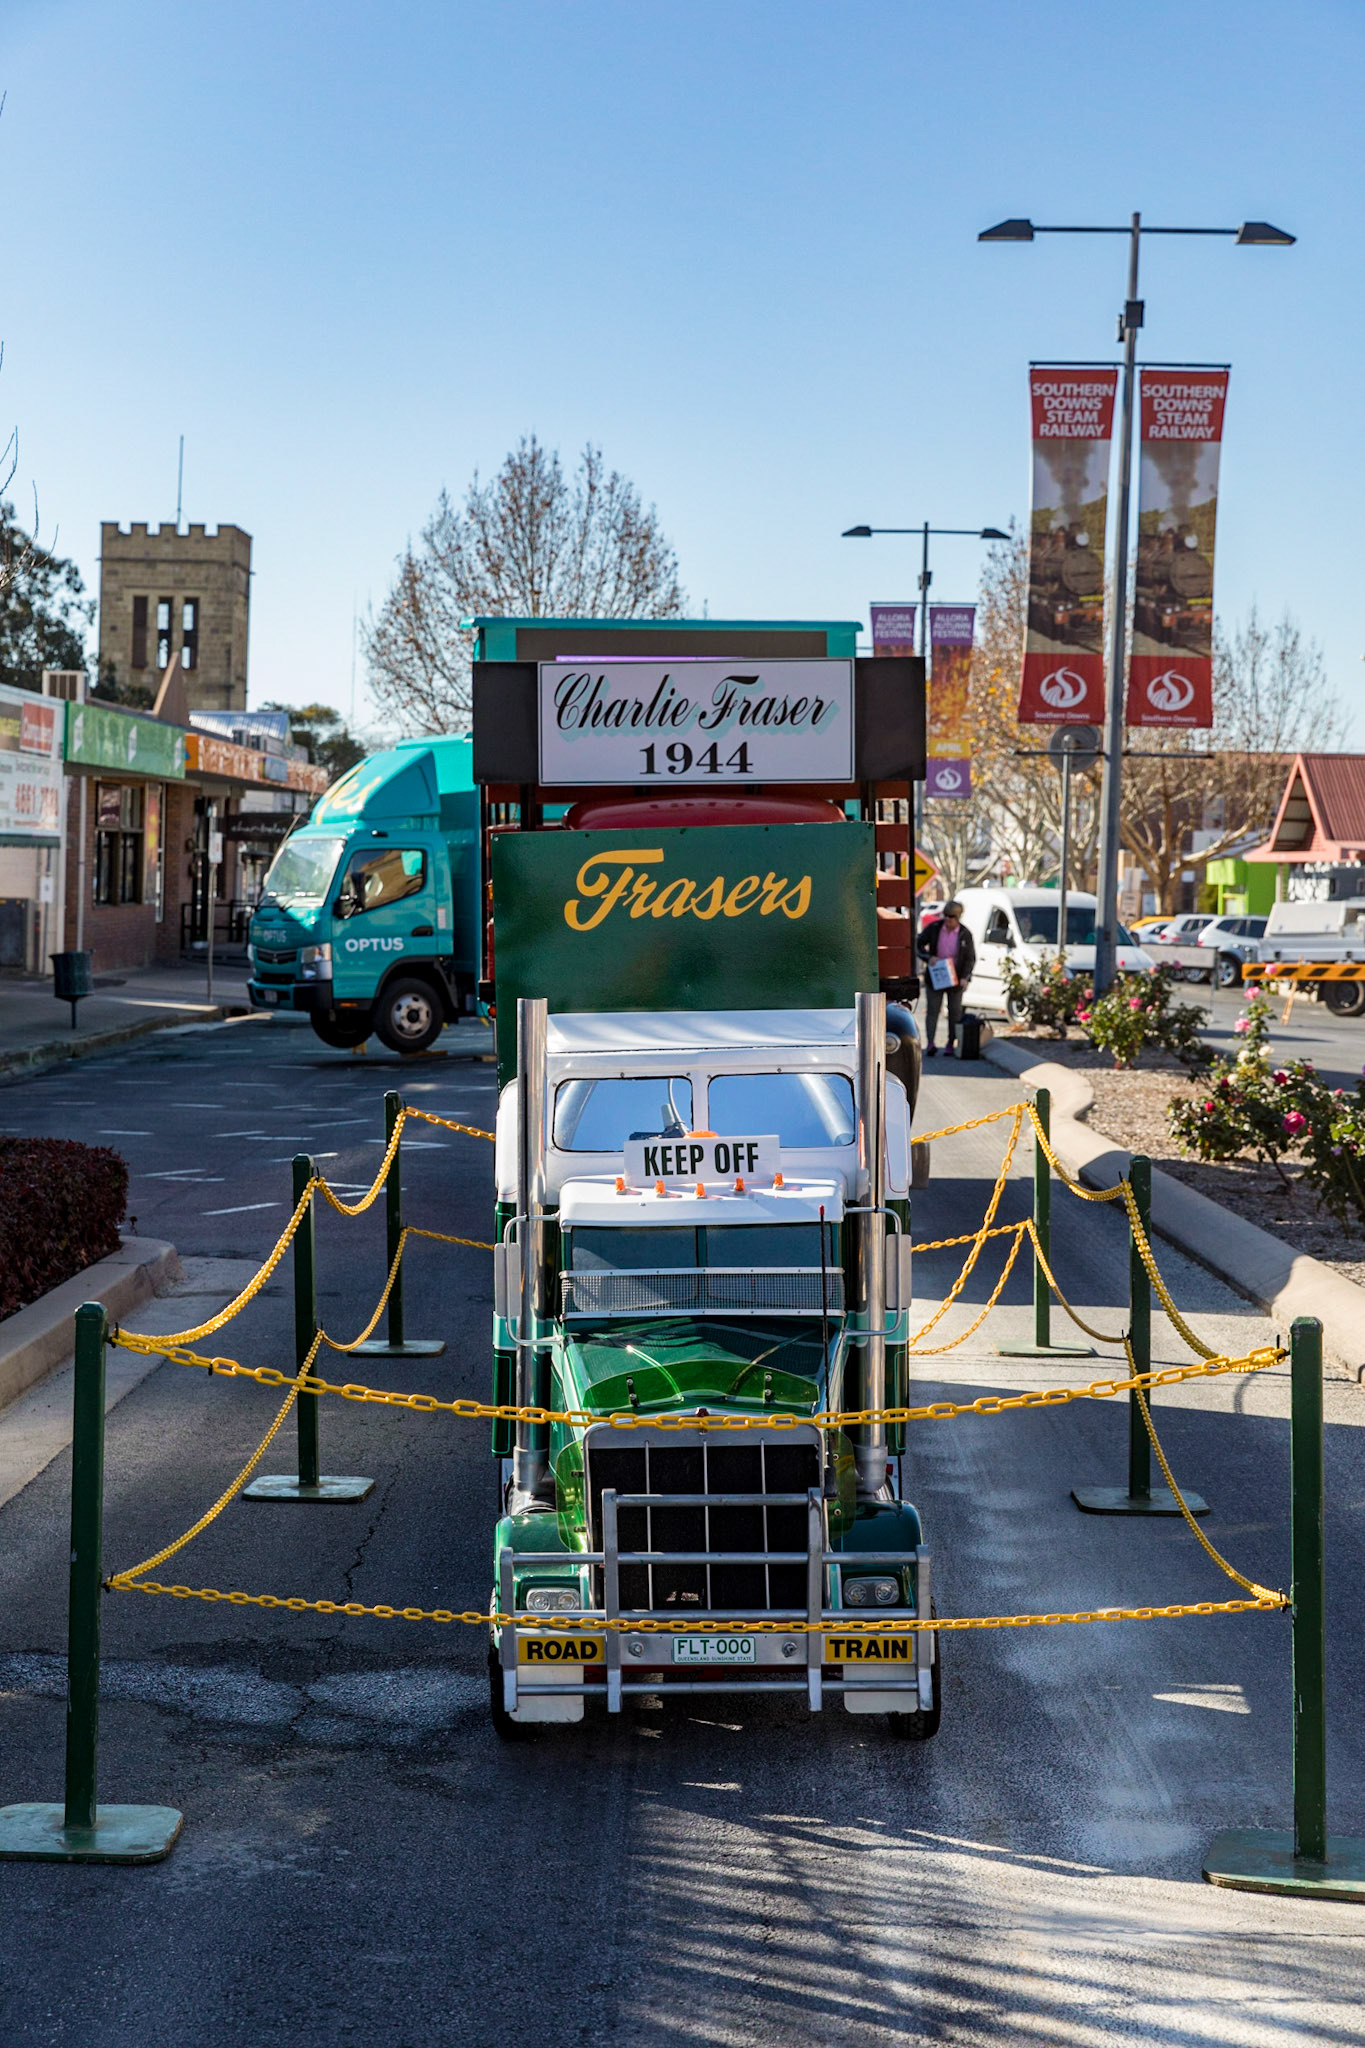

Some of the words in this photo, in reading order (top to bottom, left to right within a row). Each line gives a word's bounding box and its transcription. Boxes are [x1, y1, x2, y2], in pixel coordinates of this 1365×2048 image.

[1032, 383, 1115, 397] SOUTHERN
[1142, 384, 1225, 398] SOUTHERN
[1043, 397, 1103, 410] DOWNS
[1153, 398, 1213, 412] DOWNS
[1046, 410, 1098, 423] STEAM
[1156, 412, 1209, 425] STEAM
[1039, 424, 1105, 437] RAILWAY
[1149, 425, 1215, 439] RAILWAY
[877, 613, 911, 621] ALLORA
[935, 613, 970, 621] ALLORA
[874, 622, 913, 630] AUTUMN
[932, 622, 972, 630] AUTUMN
[874, 631, 913, 639] FESTIVAL
[932, 631, 972, 639] FESTIVAL
[554, 673, 698, 731] Charlie
[698, 675, 835, 730] Fraser
[1034, 711, 1066, 720] Southern
[1141, 714, 1172, 722] Southern
[639, 741, 753, 775] 1944
[564, 848, 812, 931] Frasers
[263, 929, 287, 942] OPTUS
[345, 937, 404, 952] OPTUS
[644, 1144, 704, 1176] KEEP
[714, 1142, 759, 1174] OFF
[527, 1641, 598, 1660] ROAD
[677, 1639, 752, 1655] FLT-000
[829, 1639, 908, 1659] TRAIN
